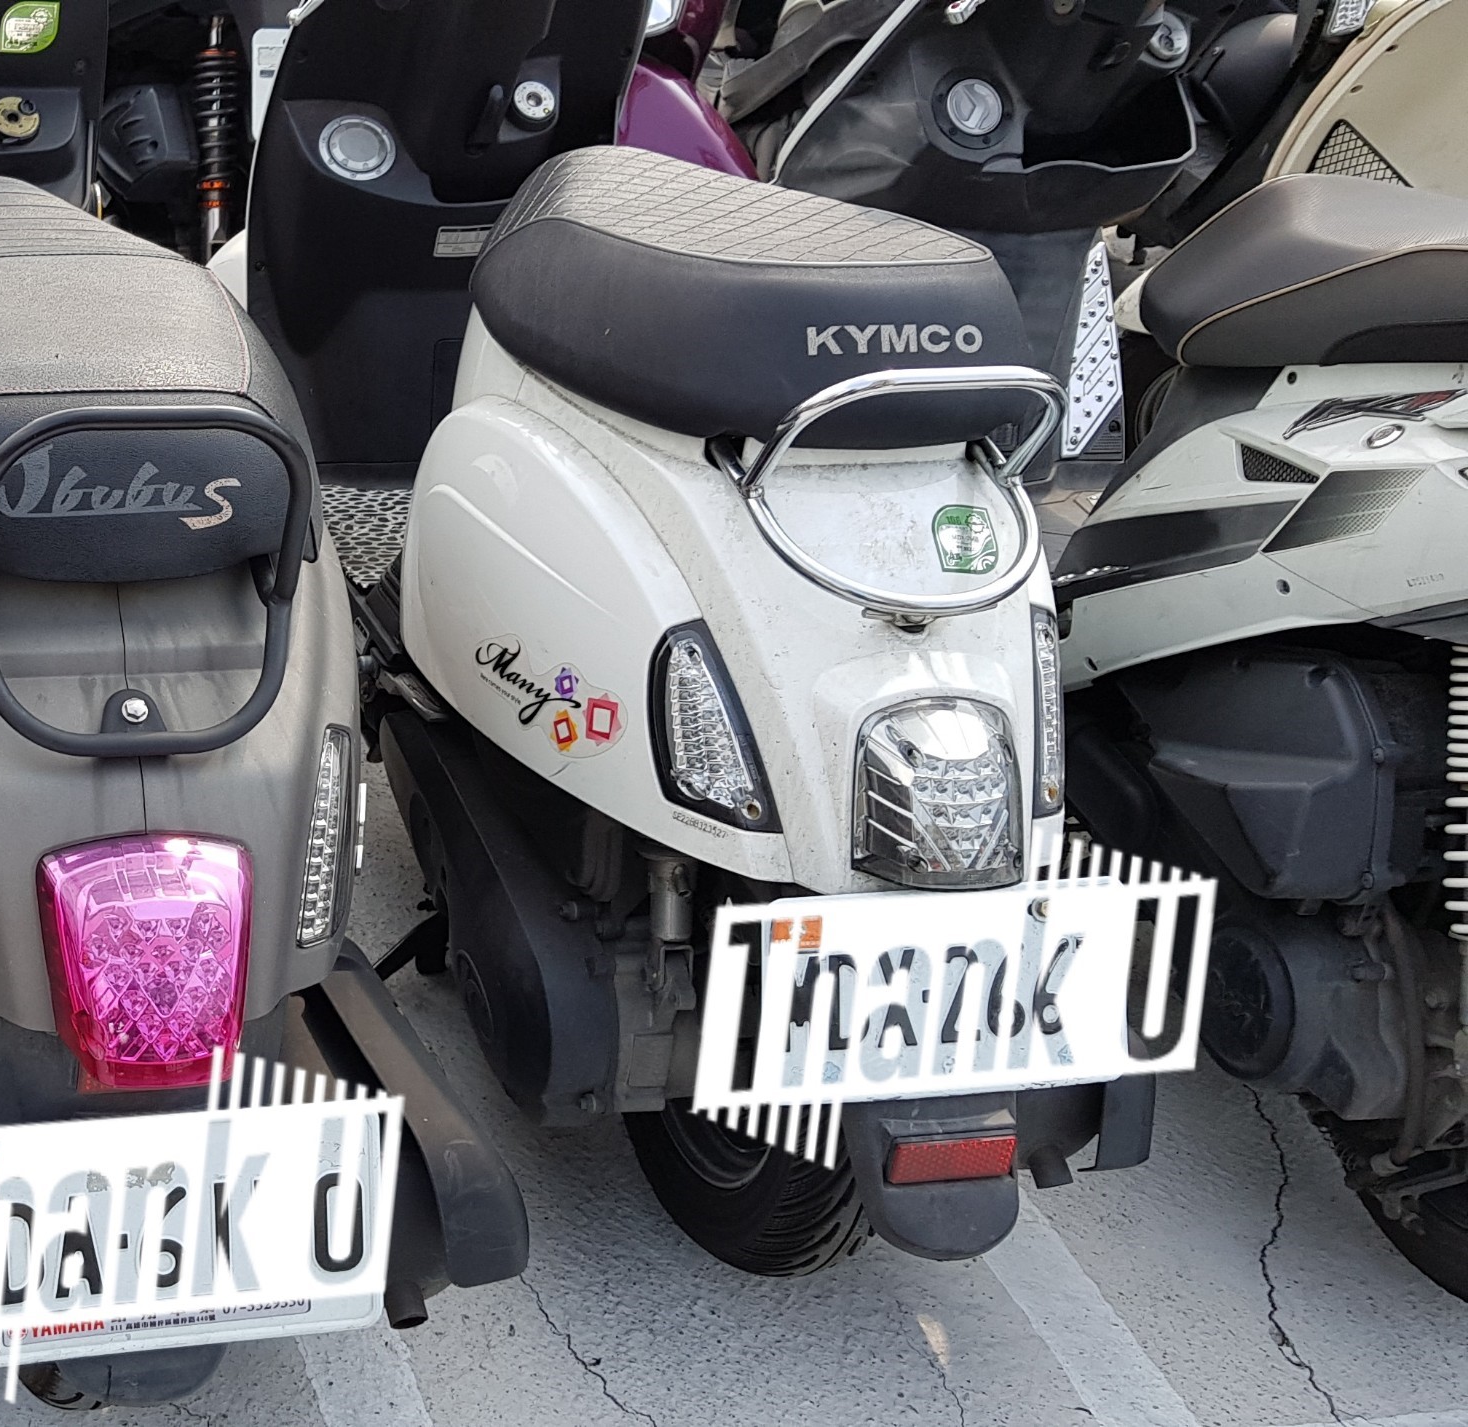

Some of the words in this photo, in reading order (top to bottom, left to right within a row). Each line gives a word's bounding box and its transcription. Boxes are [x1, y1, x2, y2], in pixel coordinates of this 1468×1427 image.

[807, 323, 983, 356] KYMCO
[475, 639, 582, 726] Many
[32, 1319, 105, 1338] YAMAHA
